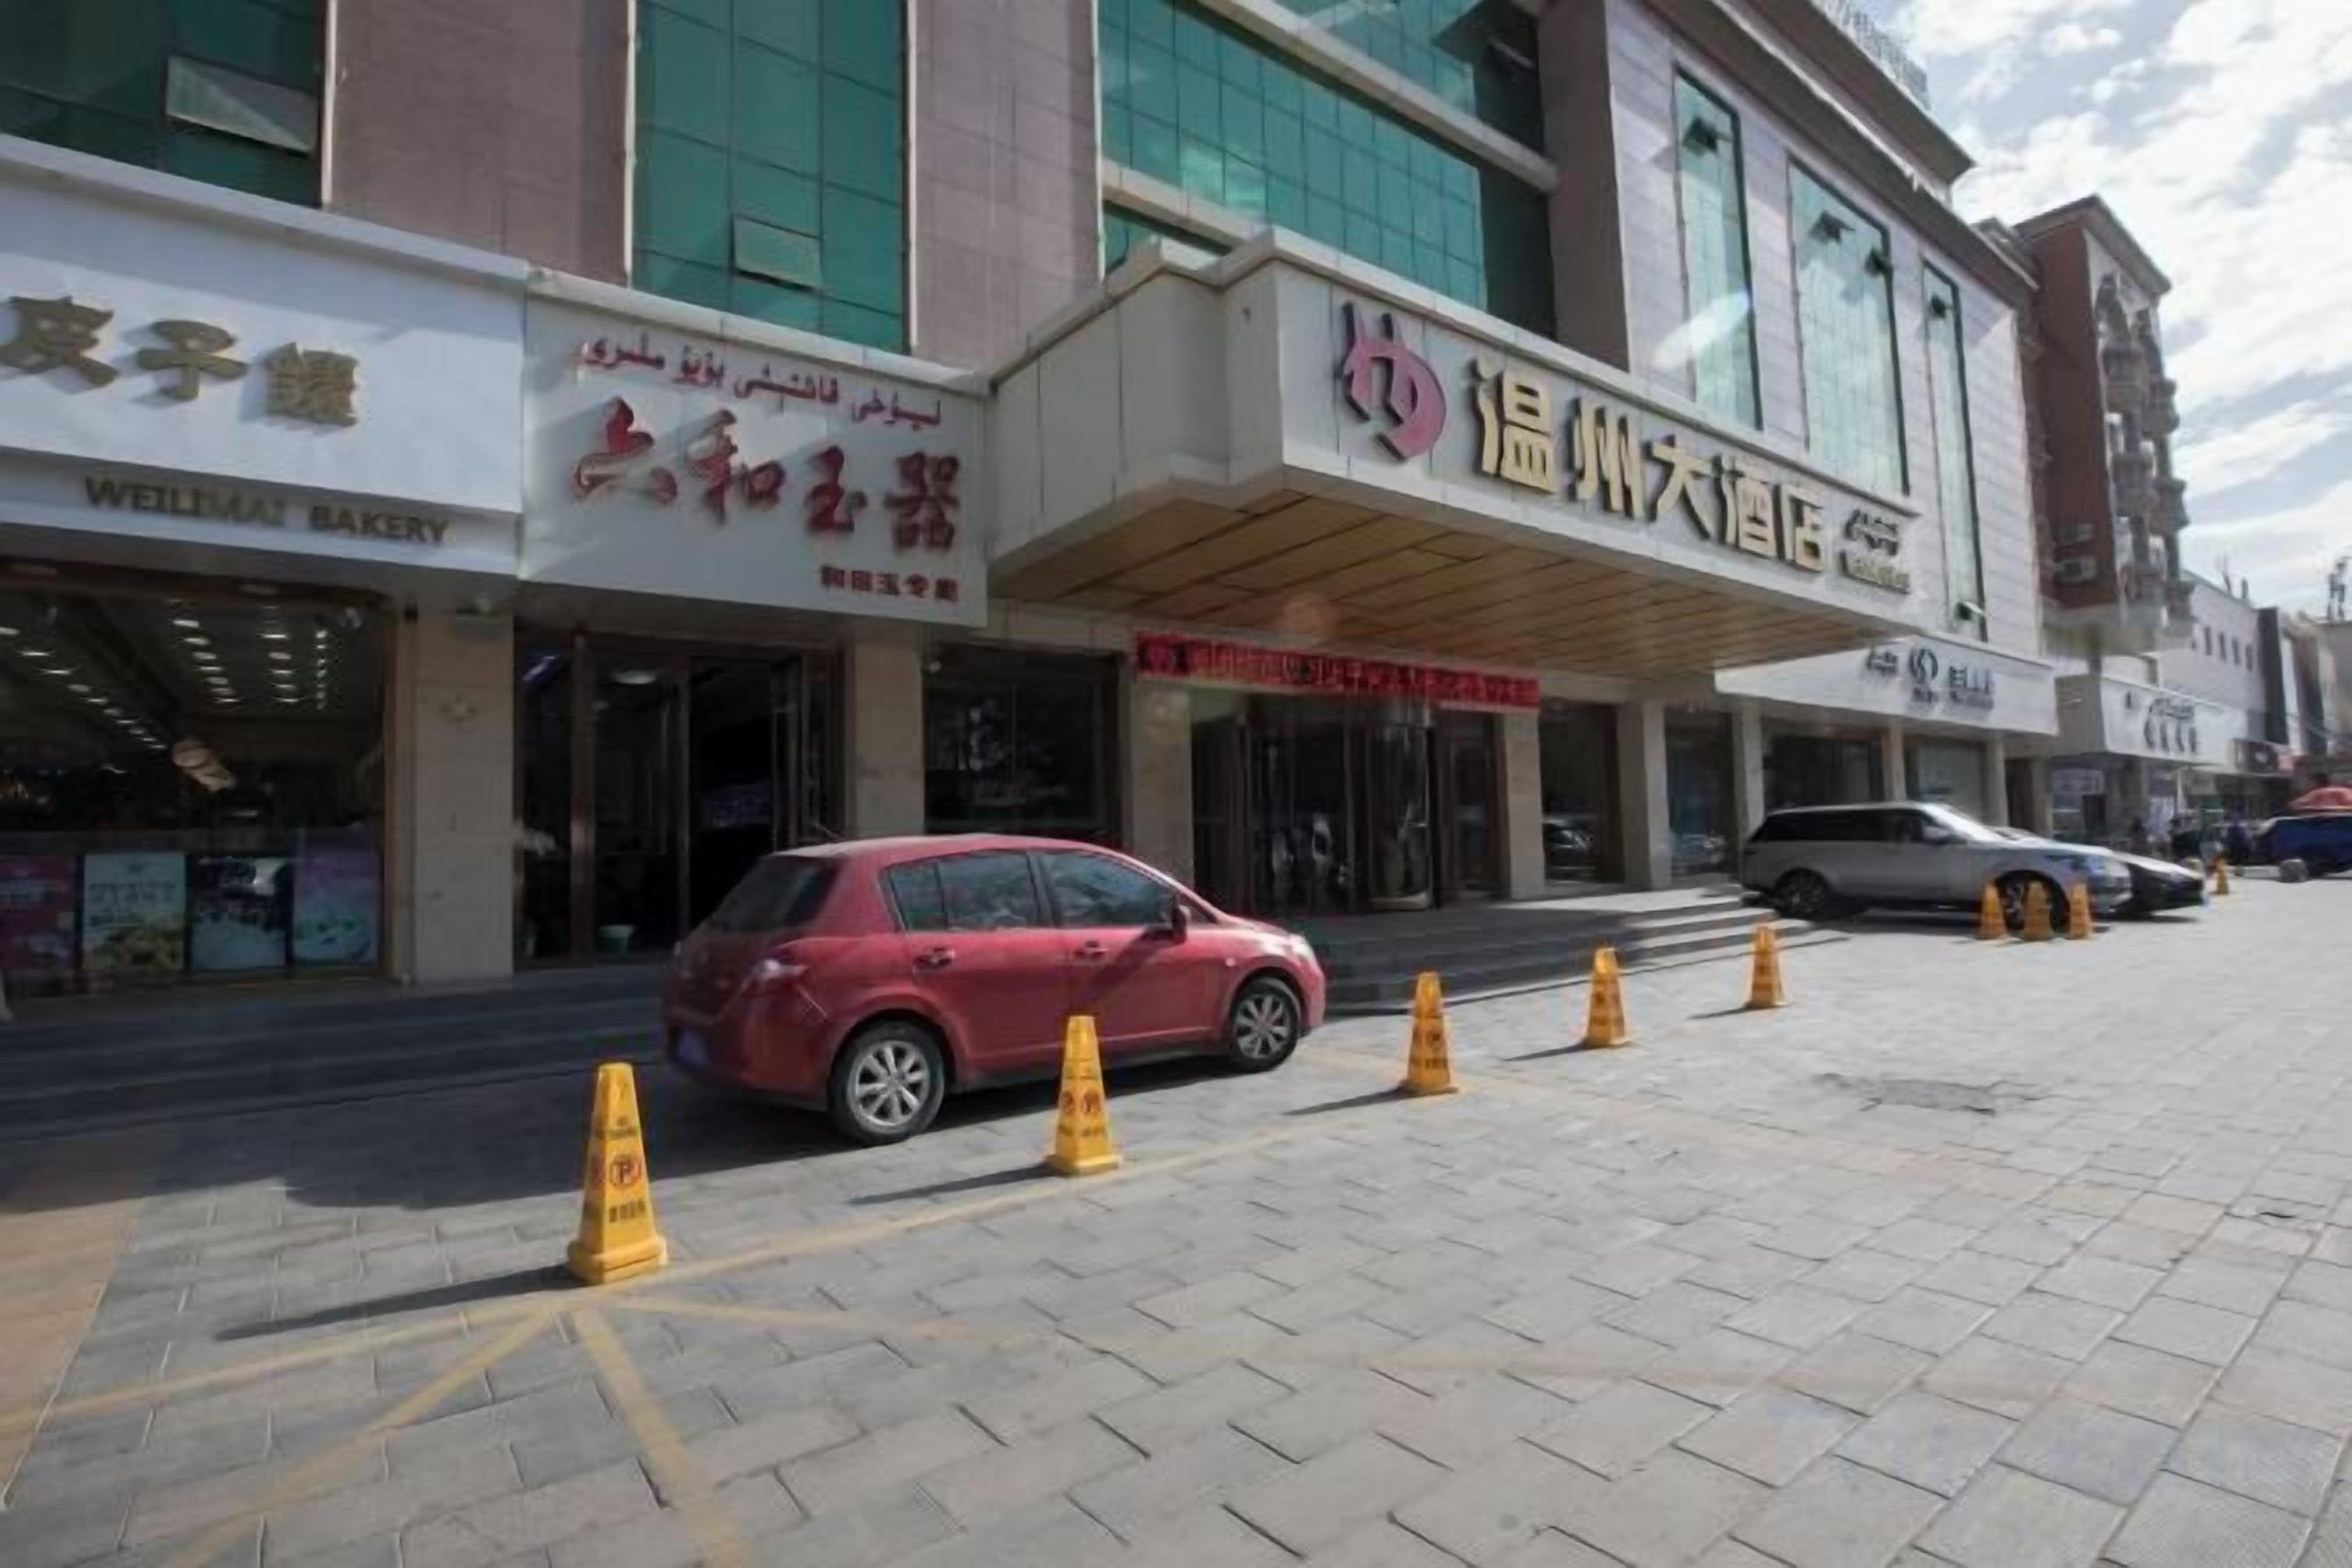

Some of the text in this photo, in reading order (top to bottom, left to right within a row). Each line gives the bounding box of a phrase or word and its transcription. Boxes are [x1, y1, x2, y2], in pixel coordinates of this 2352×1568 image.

[308, 502, 450, 544] BAKERY
[1469, 355, 1827, 573] 温州大酒店
